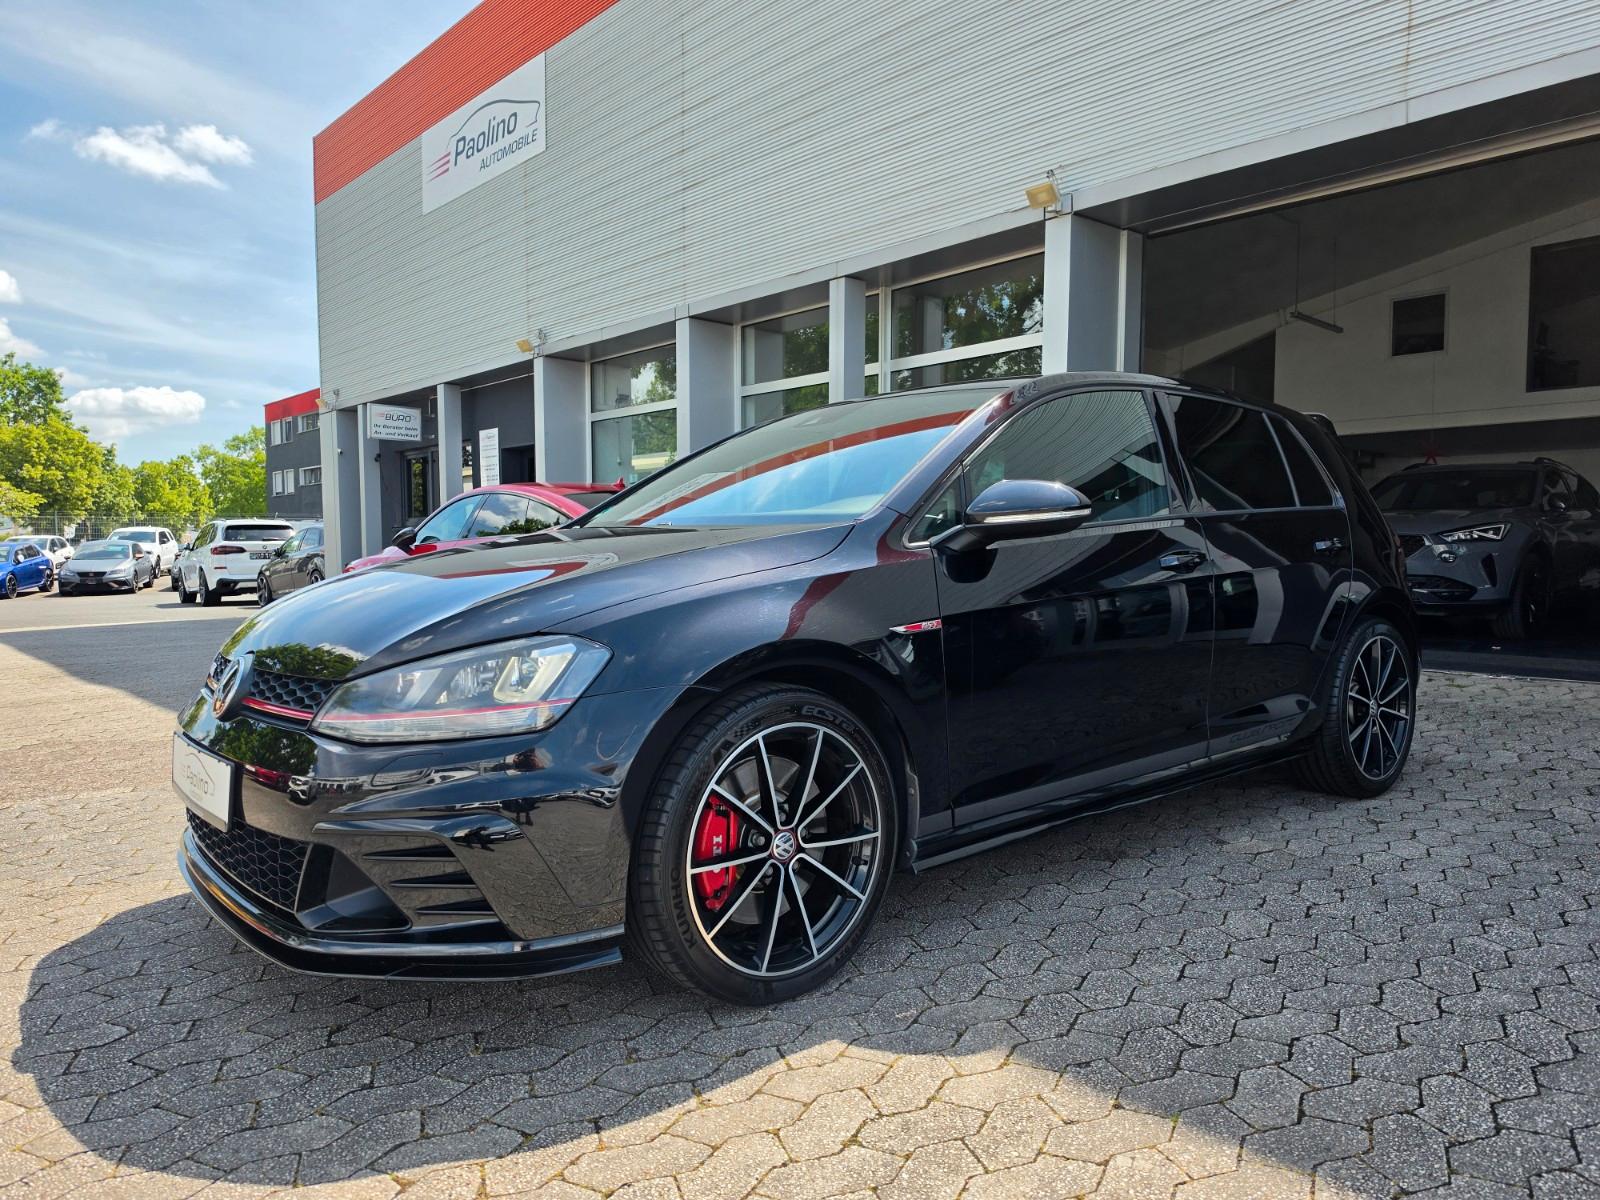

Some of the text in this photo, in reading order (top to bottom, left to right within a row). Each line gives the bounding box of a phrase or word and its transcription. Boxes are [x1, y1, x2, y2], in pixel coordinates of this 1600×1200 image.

[453, 111, 518, 167] Paolino
[479, 128, 538, 172] AUTOMOBILE
[670, 867, 697, 949] KUMHO
